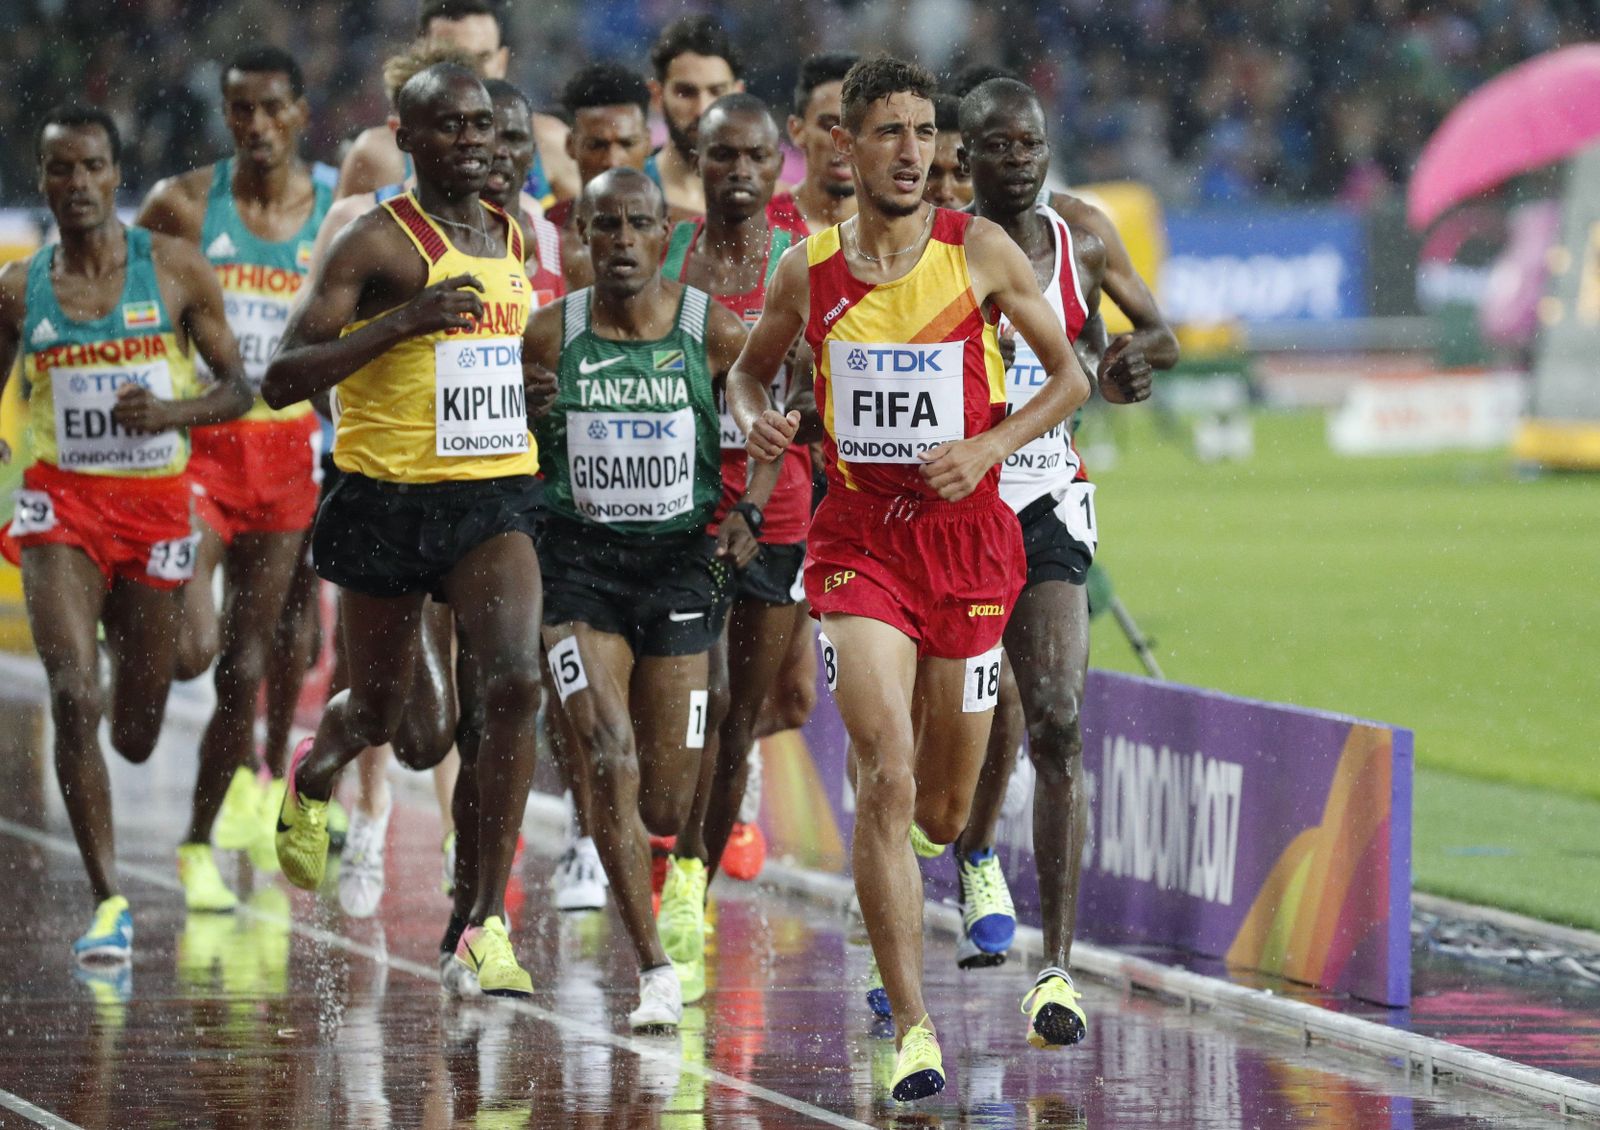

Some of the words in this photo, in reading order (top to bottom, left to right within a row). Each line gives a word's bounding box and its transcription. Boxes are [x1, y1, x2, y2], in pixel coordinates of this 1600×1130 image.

[35, 335, 169, 372] ETHIOPIA
[868, 350, 943, 372] TDK
[576, 377, 689, 406] TANZANIA
[853, 390, 938, 428] FIFA
[608, 420, 677, 439] TDK
[443, 435, 513, 450] LONDON
[838, 440, 913, 458] LONDON
[61, 449, 133, 465] LONDON
[573, 452, 689, 490] GISAMODA
[580, 502, 653, 518] LONDON
[657, 495, 689, 515] 2017
[824, 570, 857, 593] ESP
[551, 650, 580, 694] 15
[973, 662, 1000, 700] 18
